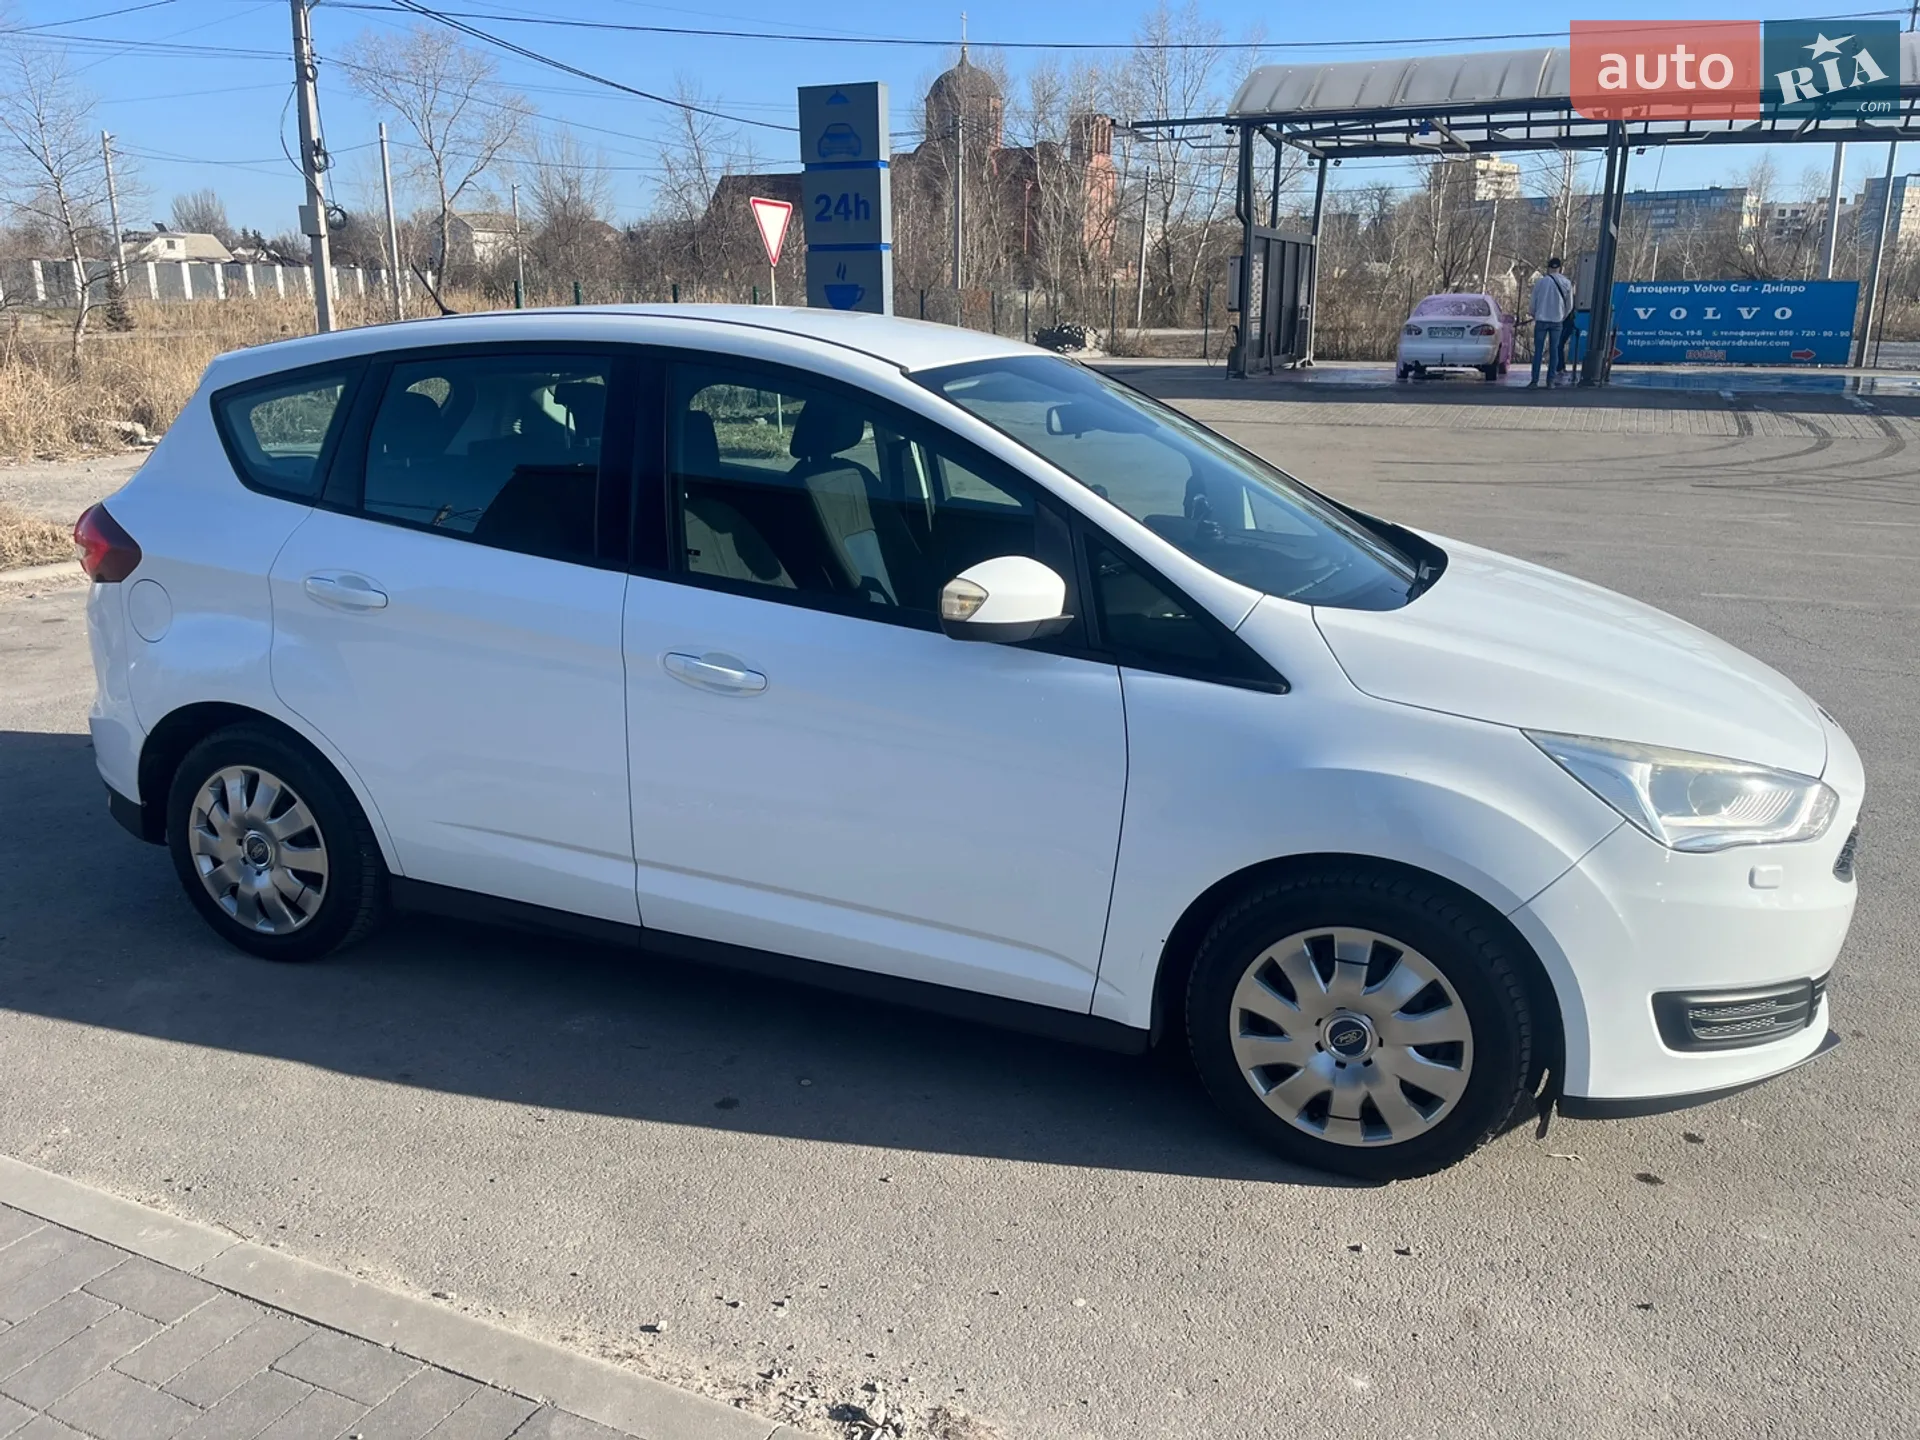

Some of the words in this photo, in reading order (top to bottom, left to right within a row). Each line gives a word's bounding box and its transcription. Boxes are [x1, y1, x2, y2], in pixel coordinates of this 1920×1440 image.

[814, 193, 871, 222] 24h
[1628, 284, 1691, 295] Автоцентр
[1693, 284, 1727, 293] Volvo
[1730, 283, 1751, 293] Car
[1761, 283, 1807, 295] Дніпро
[1634, 306, 1793, 320] VOLVO
